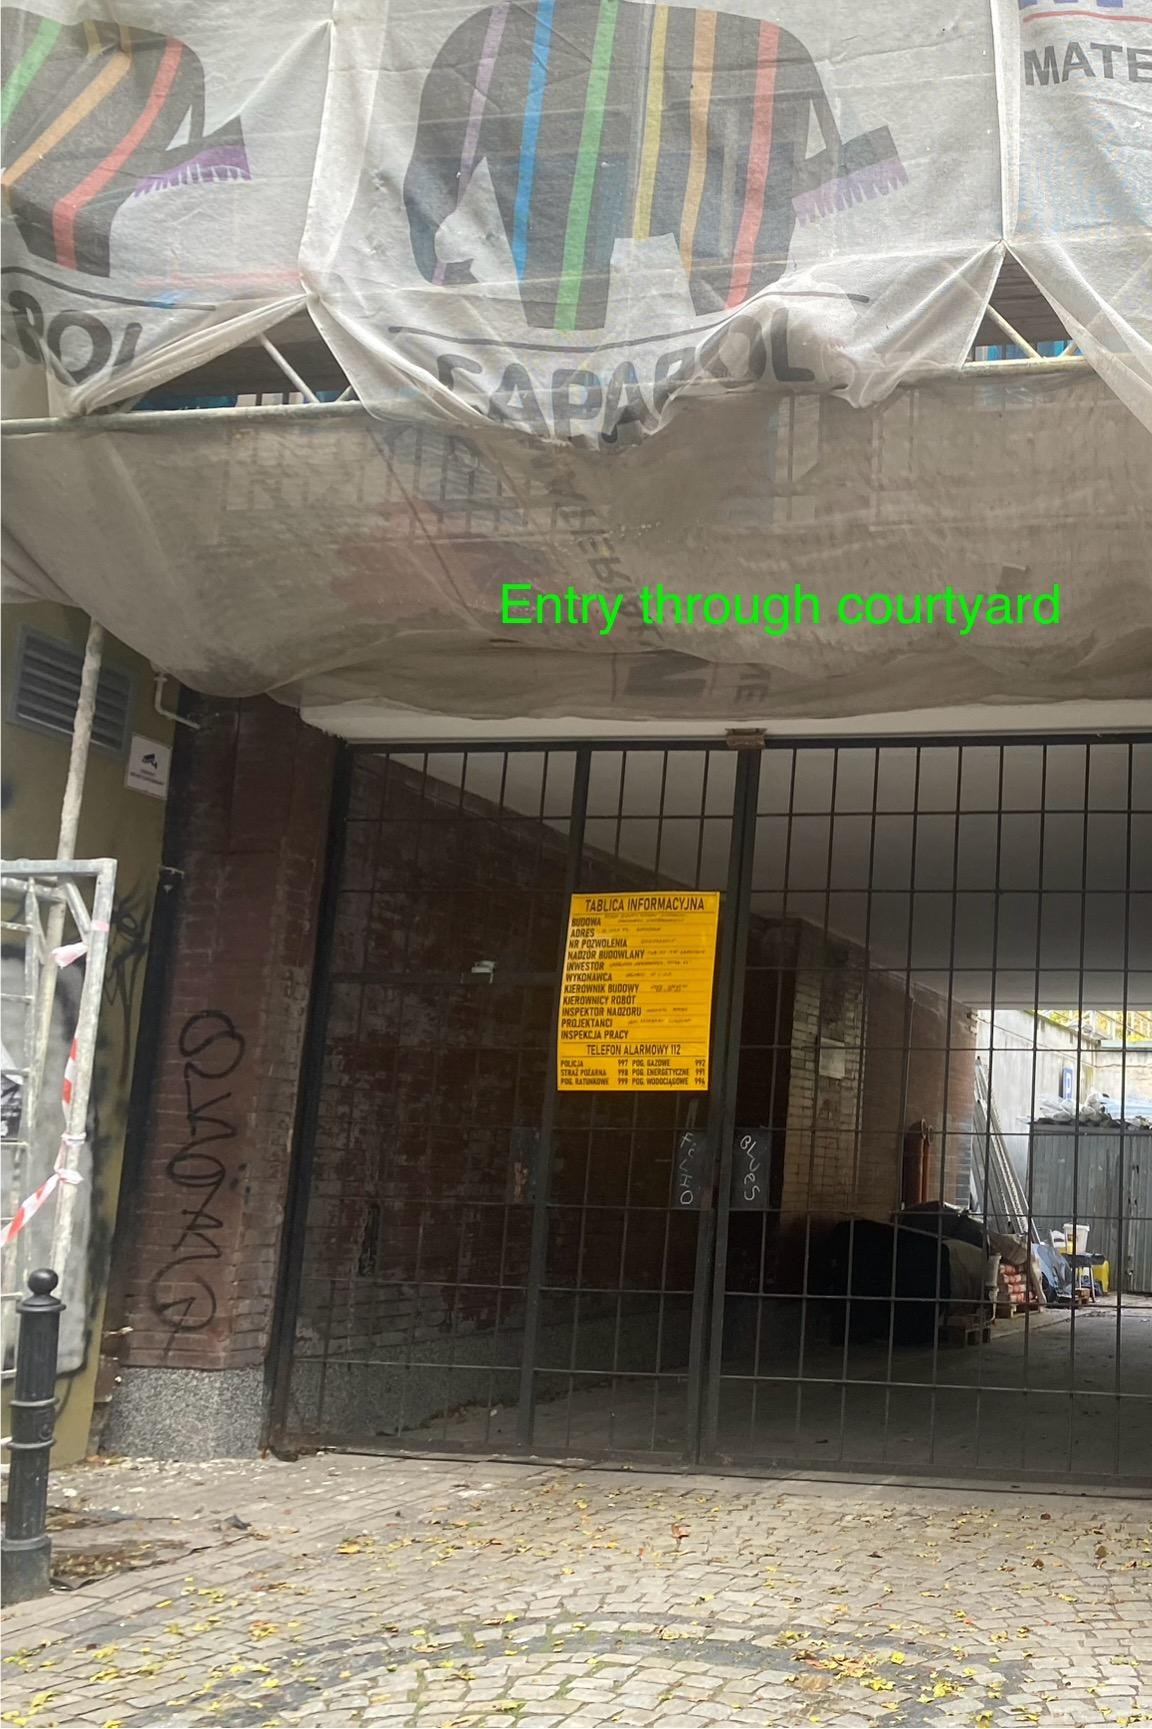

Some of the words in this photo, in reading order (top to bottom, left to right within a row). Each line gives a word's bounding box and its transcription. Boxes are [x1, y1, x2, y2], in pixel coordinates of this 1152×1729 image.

[585, 897, 625, 912] TABLICA
[627, 896, 706, 912] INFORMACYJNA
[570, 917, 602, 927] BUDOWA
[570, 928, 595, 938] ADRES
[568, 939, 581, 949] NR
[581, 938, 628, 949] POZWOLENIA
[599, 949, 645, 960] BUDOWLANY
[566, 961, 605, 971] INWESTOR
[565, 972, 613, 982] WYKONAWCA
[564, 983, 606, 994] KIEROWNIK
[608, 983, 640, 993] BUDOWY
[563, 995, 610, 1006] KIEROWNICY
[561, 1007, 605, 1017] INSPEKTOR
[561, 1018, 613, 1028] PROJEKTANCI
[560, 1030, 602, 1040] INSPEKCJA
[604, 1030, 629, 1040] PRACY
[587, 1044, 622, 1056] TELEFON
[623, 1044, 669, 1056] ALARMOWY
[670, 1044, 681, 1056] 112
